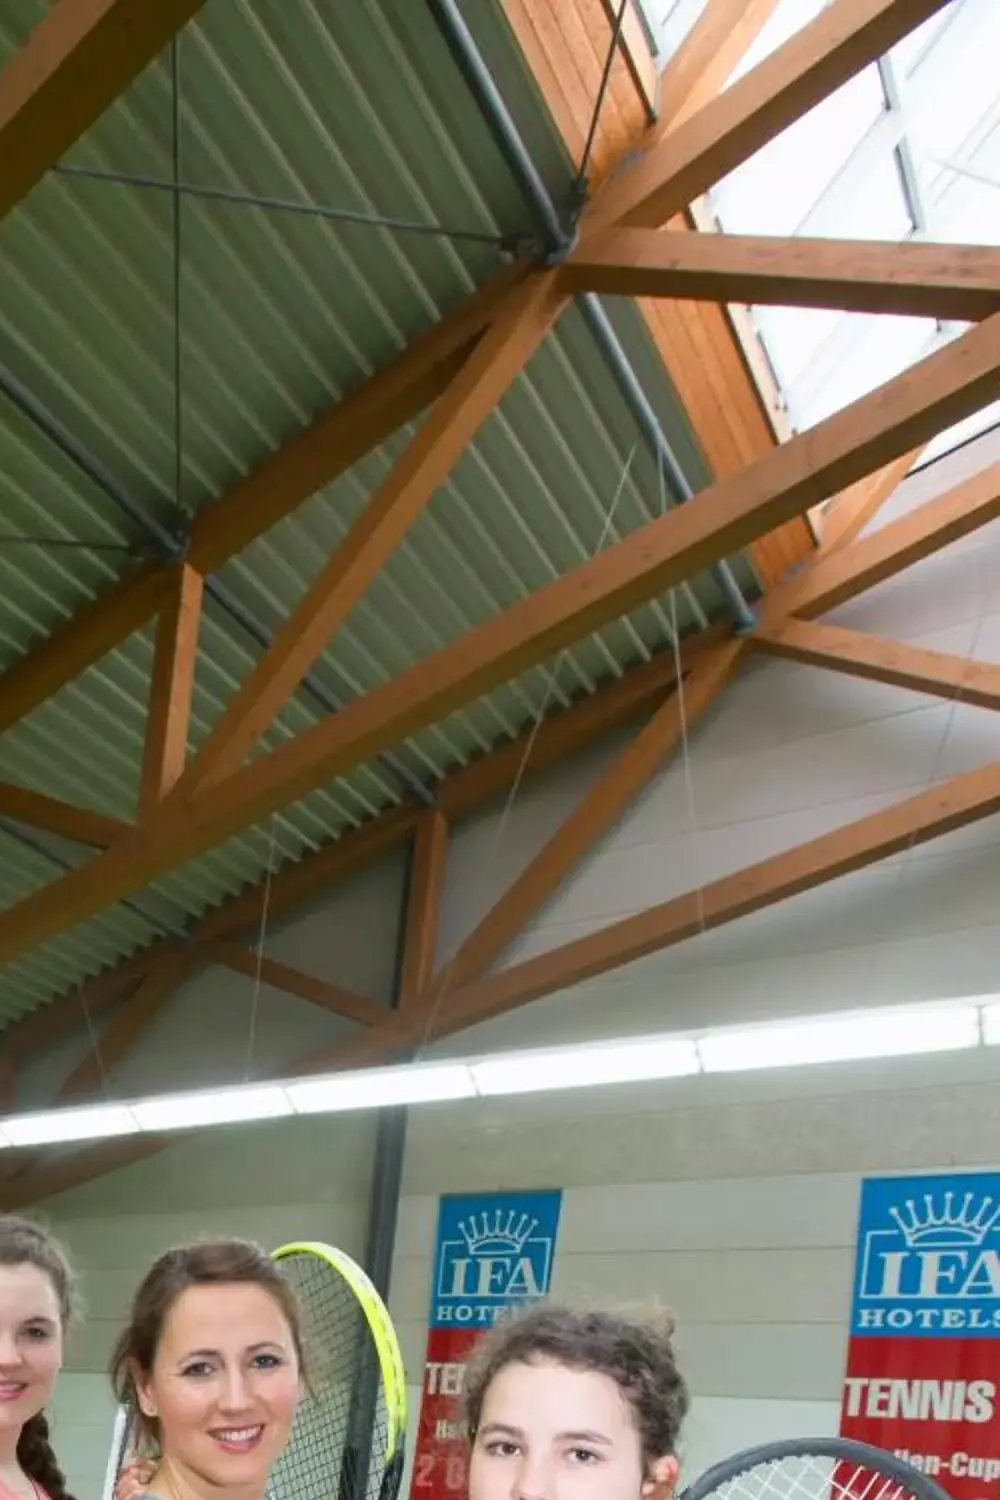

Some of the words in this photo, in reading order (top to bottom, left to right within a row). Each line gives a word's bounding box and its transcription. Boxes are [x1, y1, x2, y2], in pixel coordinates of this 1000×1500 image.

[451, 1257, 541, 1297] IFA
[877, 1250, 1000, 1299] IFA
[844, 1377, 996, 1423] TENNIS
